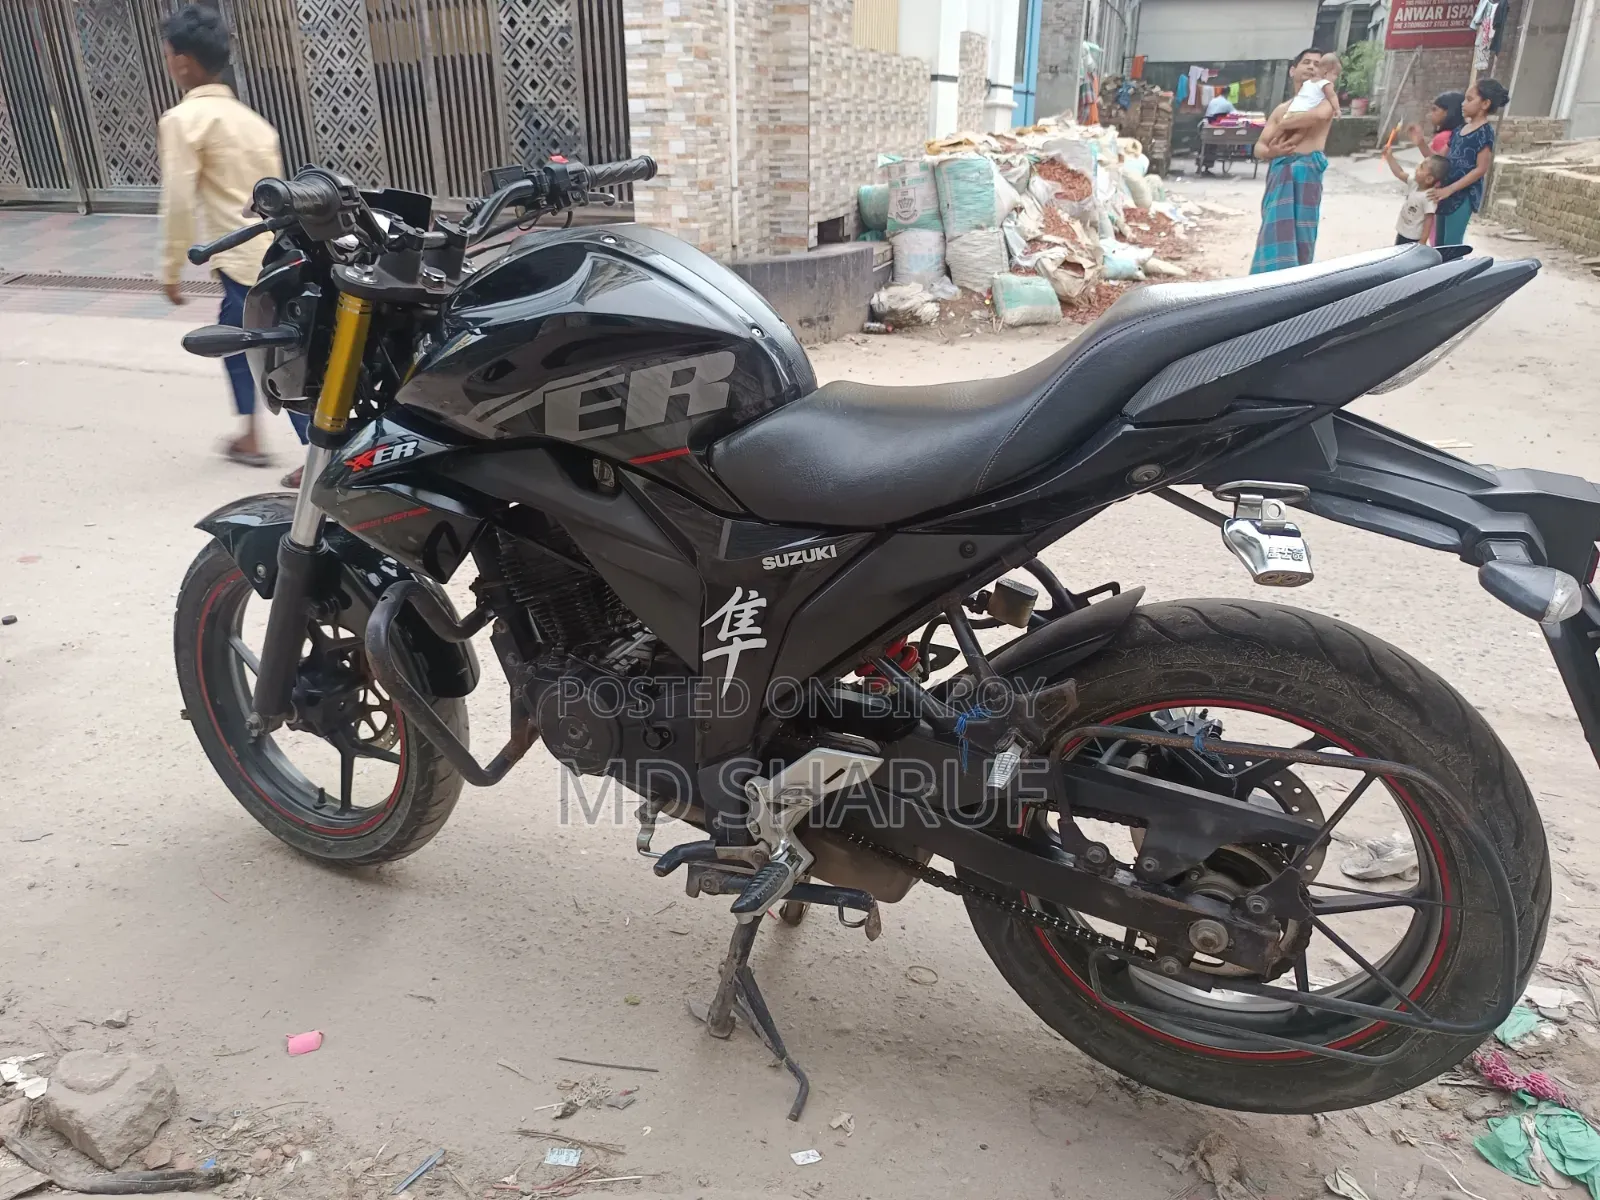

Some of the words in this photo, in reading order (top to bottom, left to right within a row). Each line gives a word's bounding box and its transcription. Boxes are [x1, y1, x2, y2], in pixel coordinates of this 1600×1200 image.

[1394, 7, 1443, 21] ANWAR
[1447, 5, 1477, 19] ISPA
[762, 544, 838, 571] SUZUKI
[701, 586, 768, 699] 隼
